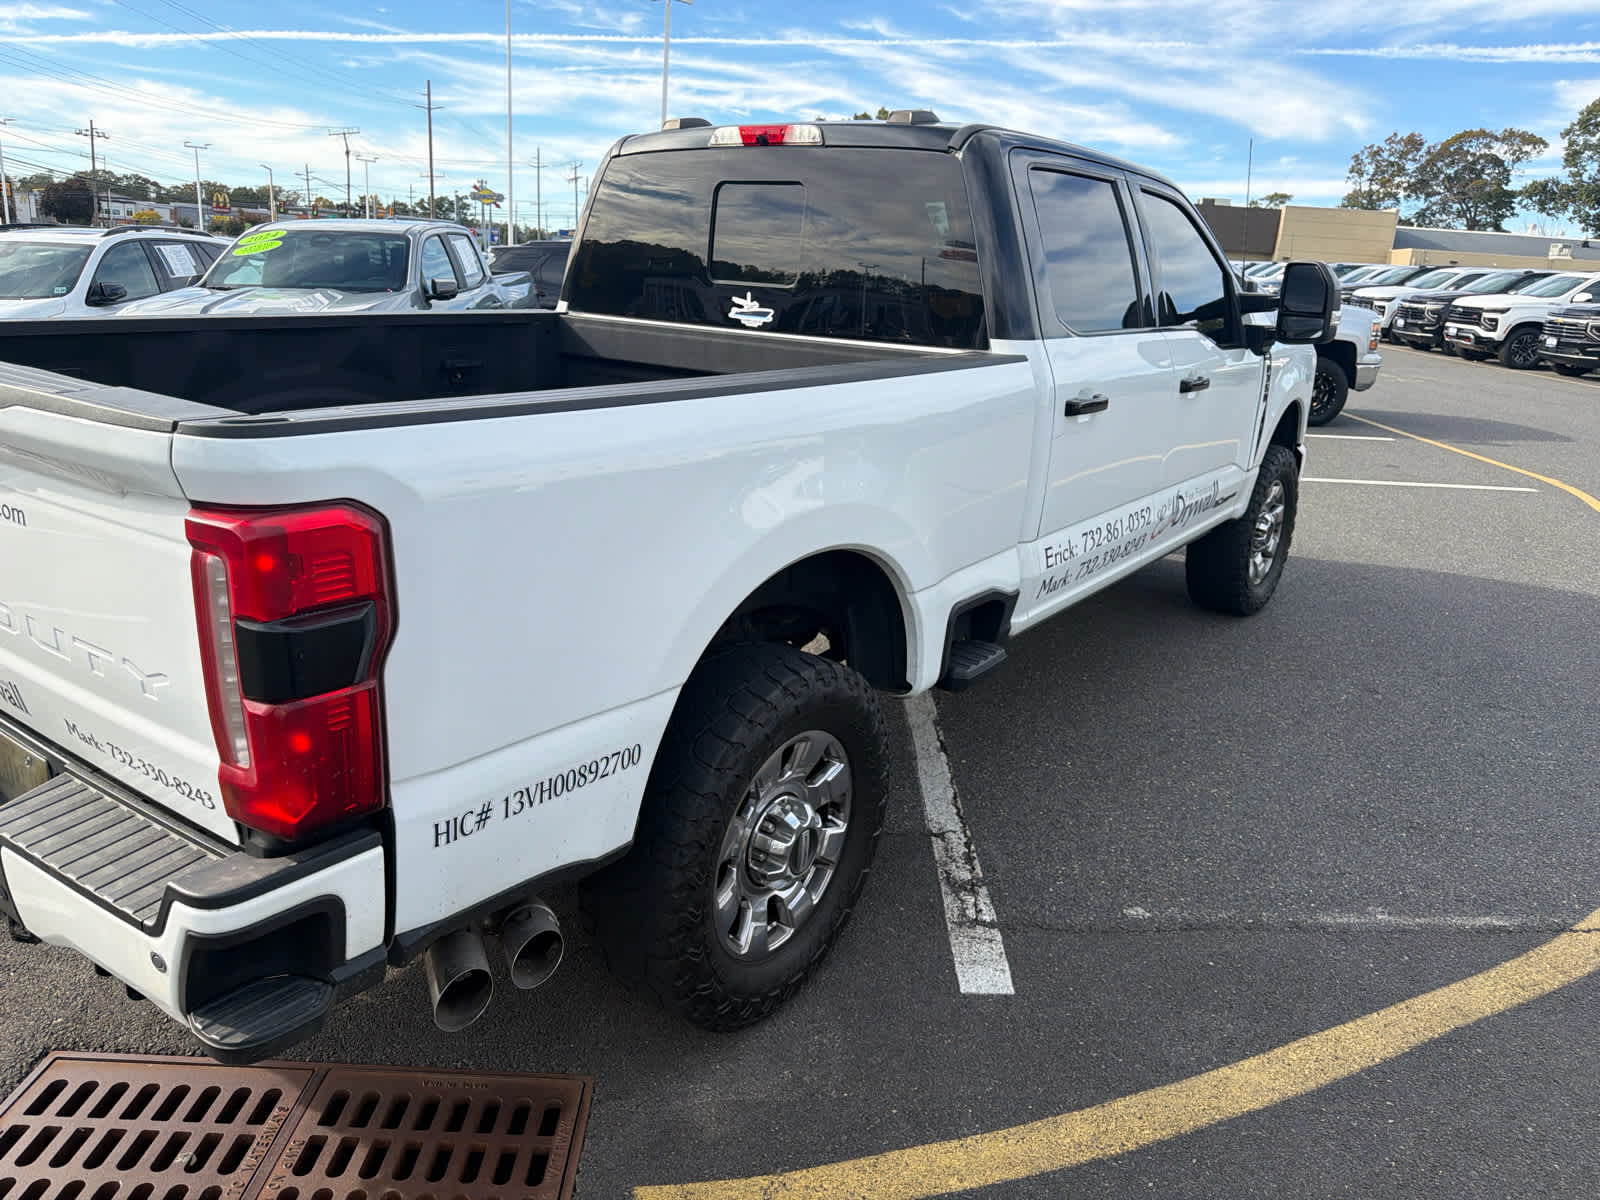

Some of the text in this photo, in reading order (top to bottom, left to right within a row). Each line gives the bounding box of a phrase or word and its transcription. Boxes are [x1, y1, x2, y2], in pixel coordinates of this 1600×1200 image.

[0, 504, 26, 527] om
[1045, 539, 1079, 569] Erick:
[1082, 506, 1152, 553] 732-861-0352
[1036, 572, 1073, 600] Mark:
[64, 718, 216, 810] Mark: 732-330-8243
[433, 743, 642, 848] HIC# 13VH00892700
